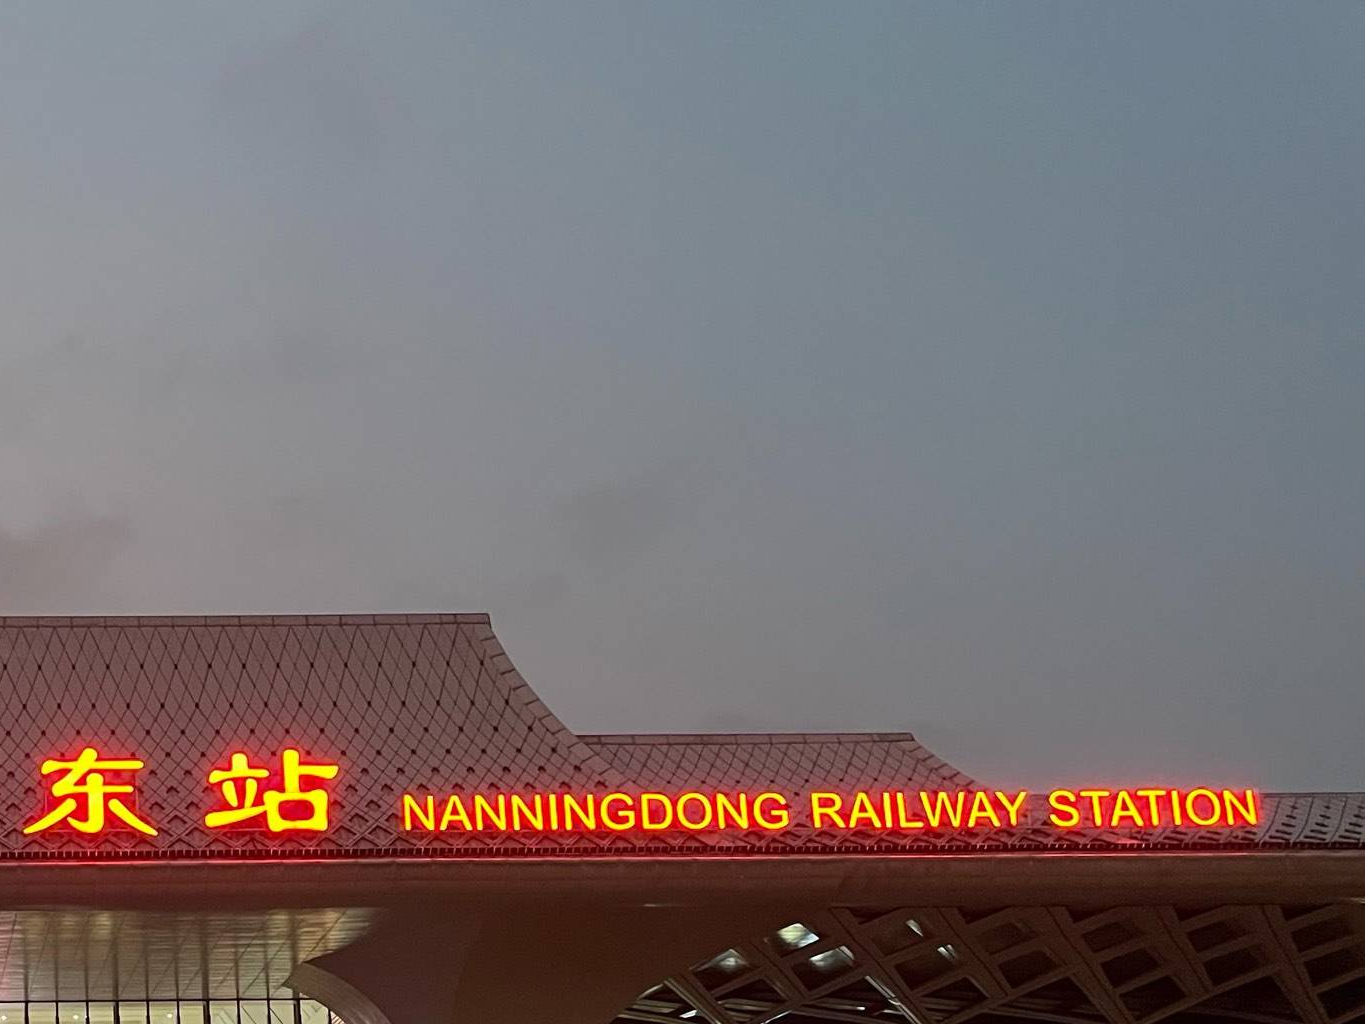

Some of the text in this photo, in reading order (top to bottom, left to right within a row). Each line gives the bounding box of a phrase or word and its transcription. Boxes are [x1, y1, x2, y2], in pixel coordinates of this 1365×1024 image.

[402, 787, 1260, 832] NANNINGDONG RAILWAY STATION
